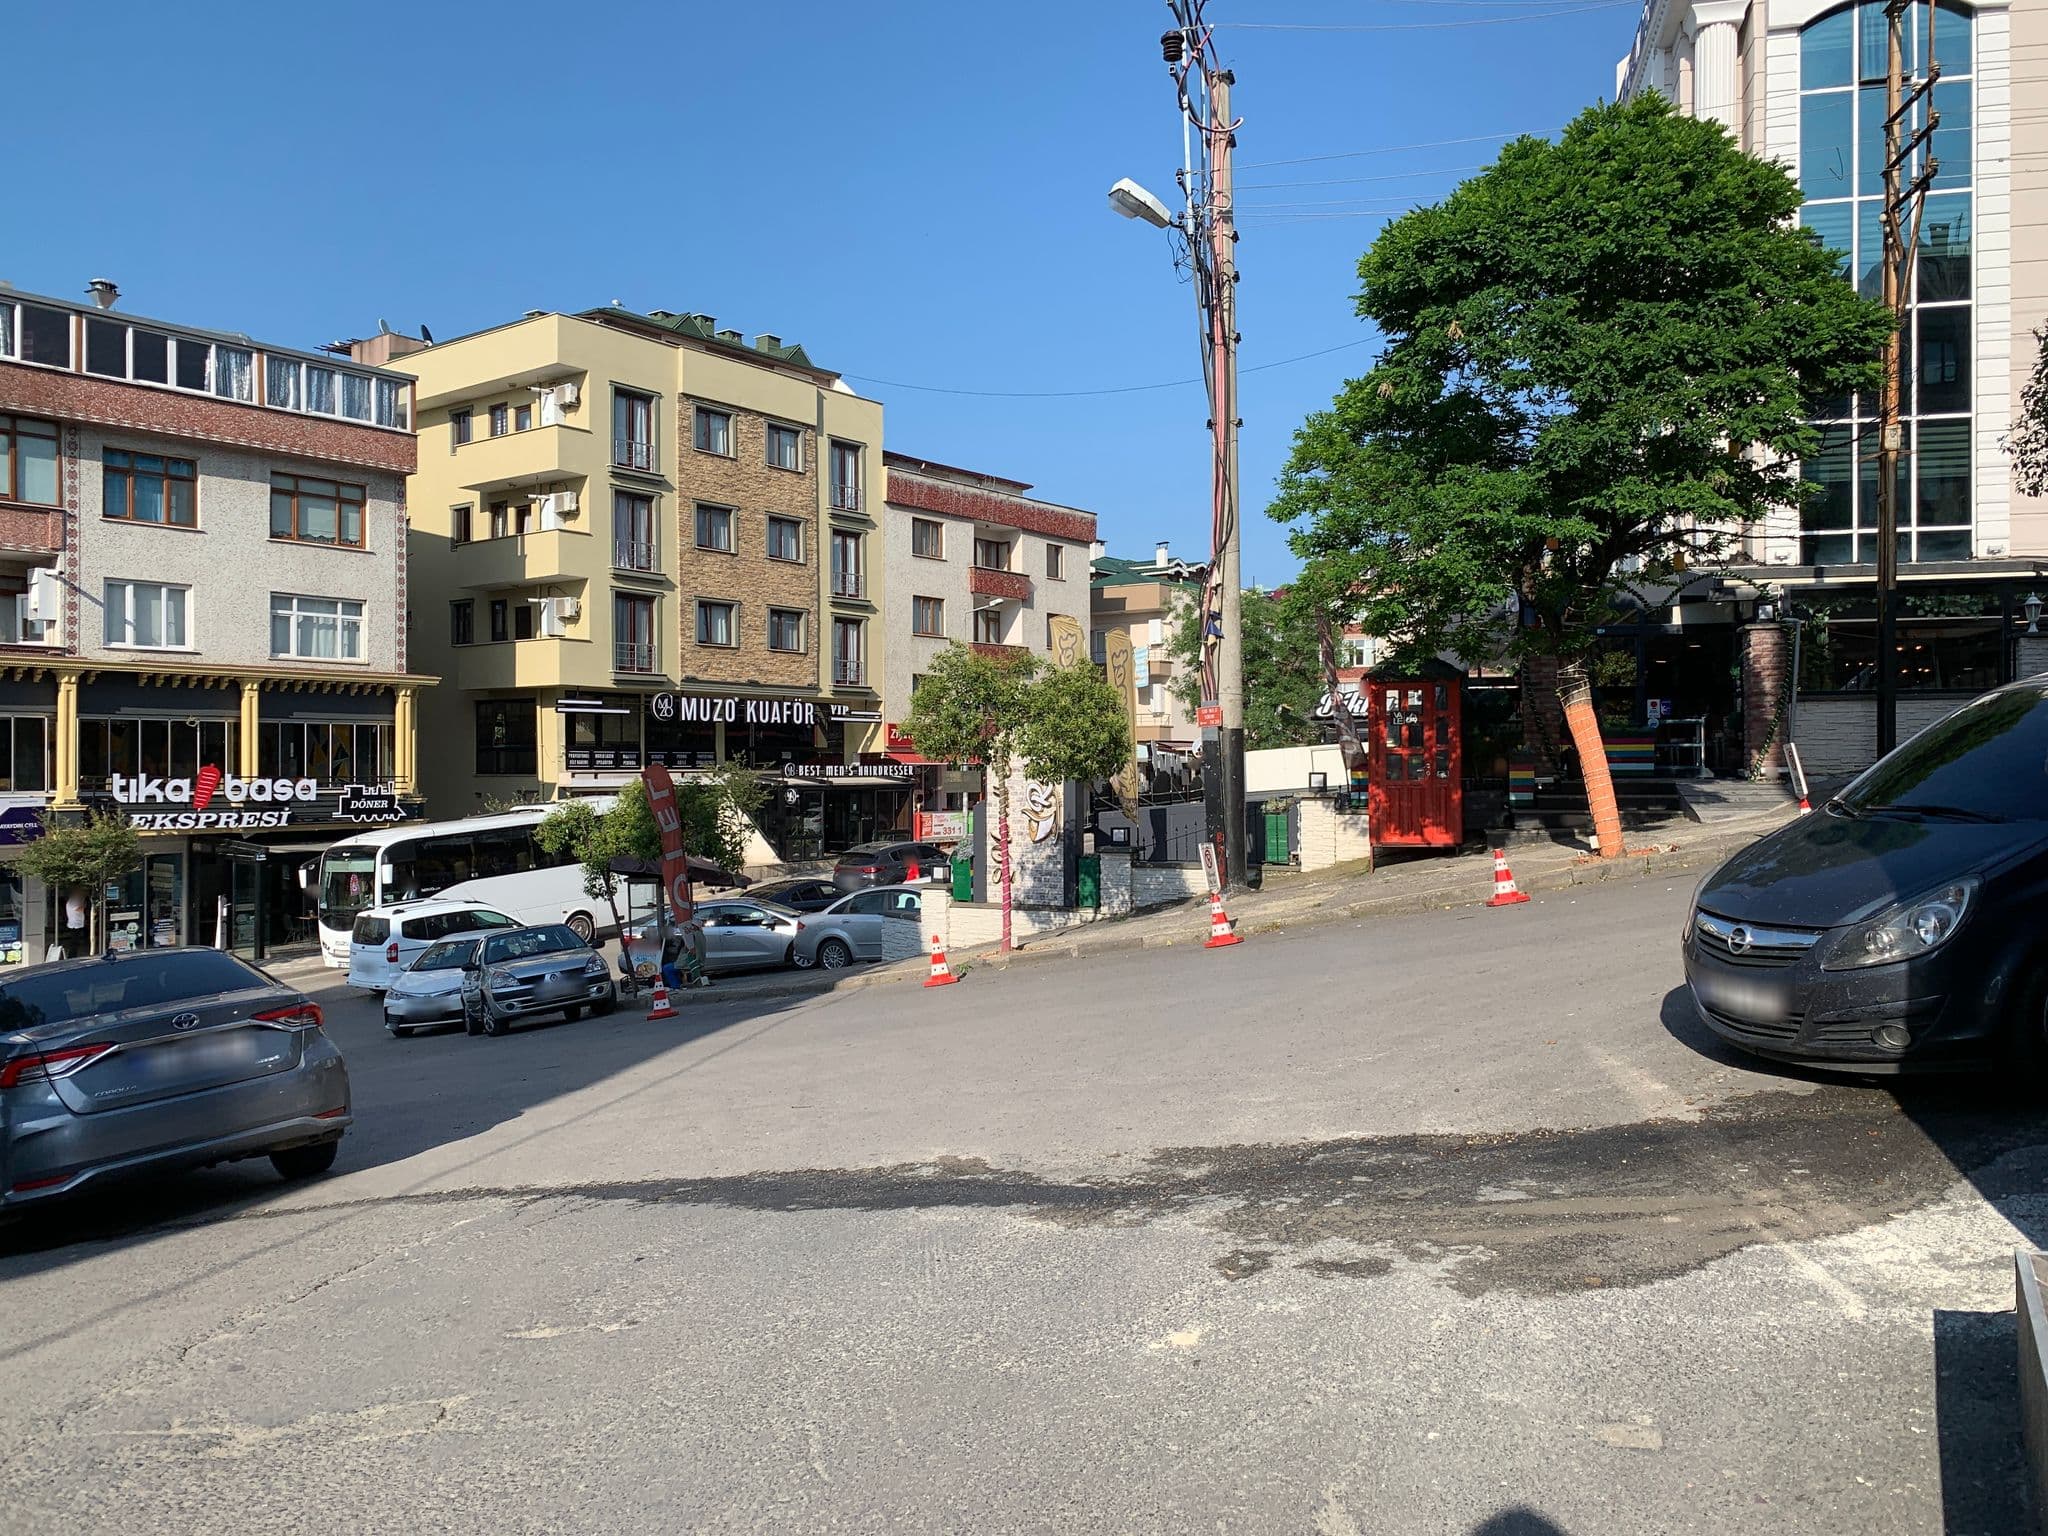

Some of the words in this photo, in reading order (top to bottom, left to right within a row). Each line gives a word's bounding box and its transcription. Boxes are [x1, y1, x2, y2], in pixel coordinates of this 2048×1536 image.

[681, 697, 736, 722] MUZO
[746, 698, 815, 725] KUAFÖR
[830, 704, 849, 716] VIP
[798, 764, 820, 777] BEST
[825, 764, 854, 777] MEN'S
[858, 764, 914, 777] HAIRDRESSER
[224, 773, 317, 802] basa
[350, 798, 388, 809] DÖNER
[128, 806, 292, 830] EKSPRESİ
